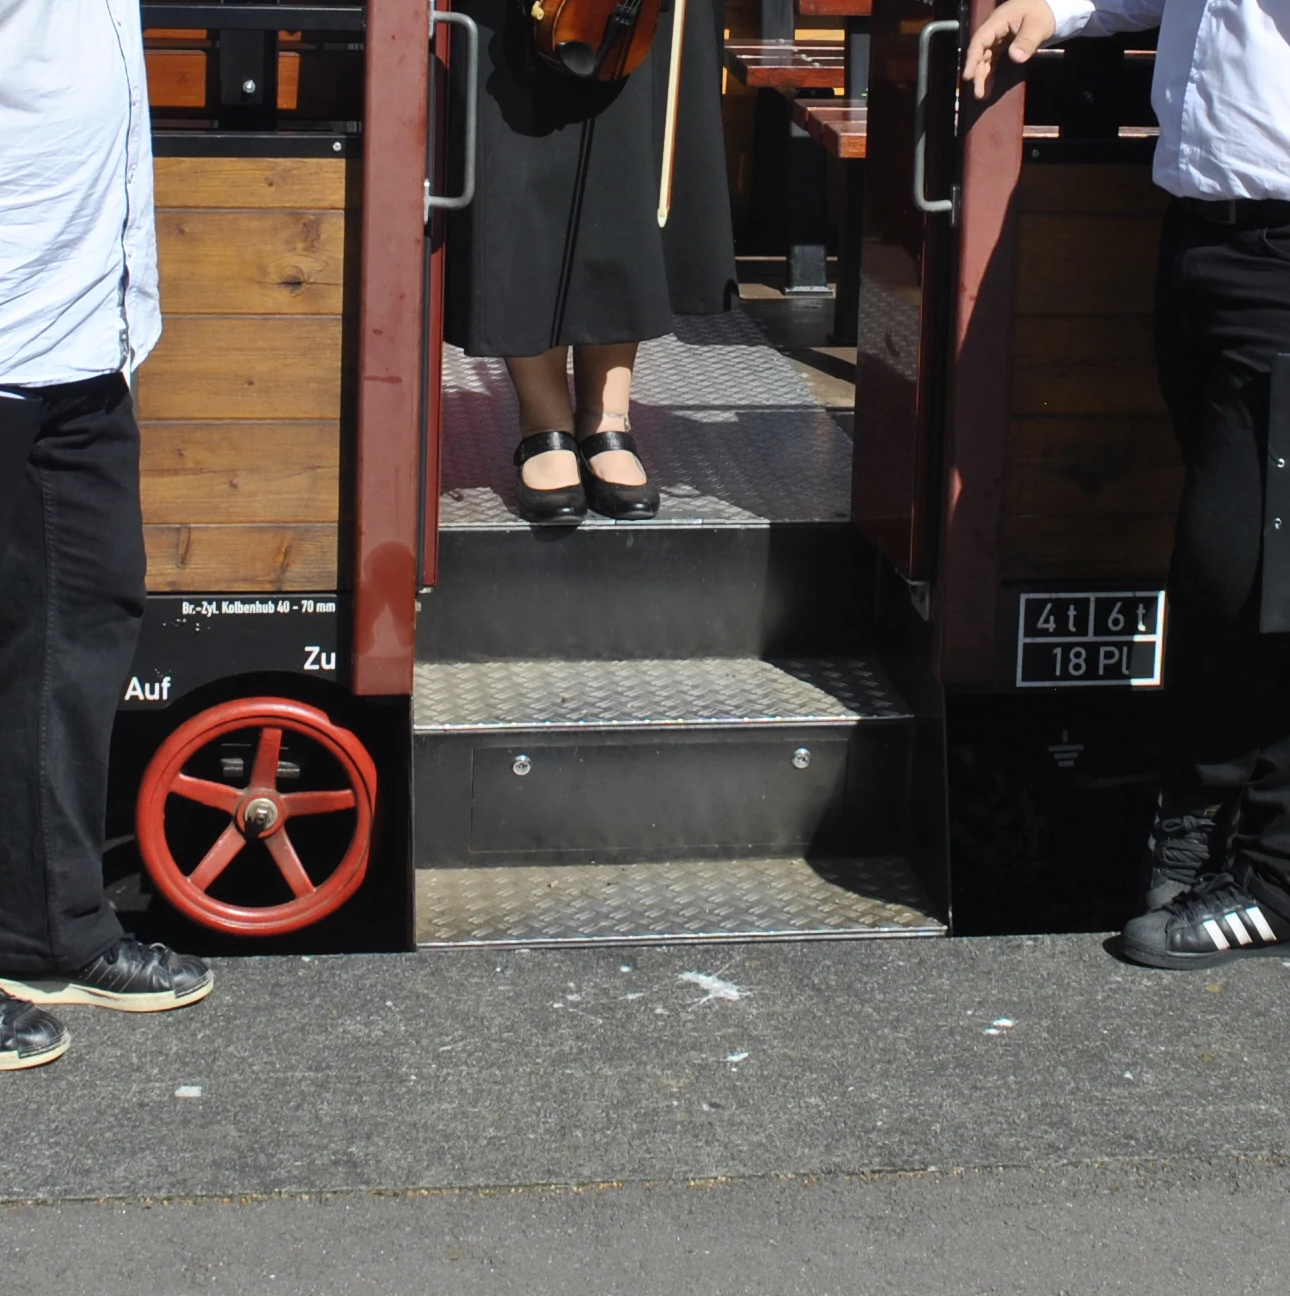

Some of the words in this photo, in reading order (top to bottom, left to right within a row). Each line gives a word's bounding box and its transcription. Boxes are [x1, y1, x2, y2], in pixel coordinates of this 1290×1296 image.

[221, 600, 275, 614] Kolbenhub
[276, 600, 290, 613] 40
[301, 599, 314, 613] 70
[316, 601, 336, 613] mm
[303, 646, 337, 670] Zu
[1052, 646, 1087, 677] 18
[1098, 646, 1130, 676] Pl
[124, 676, 172, 702] Auf
